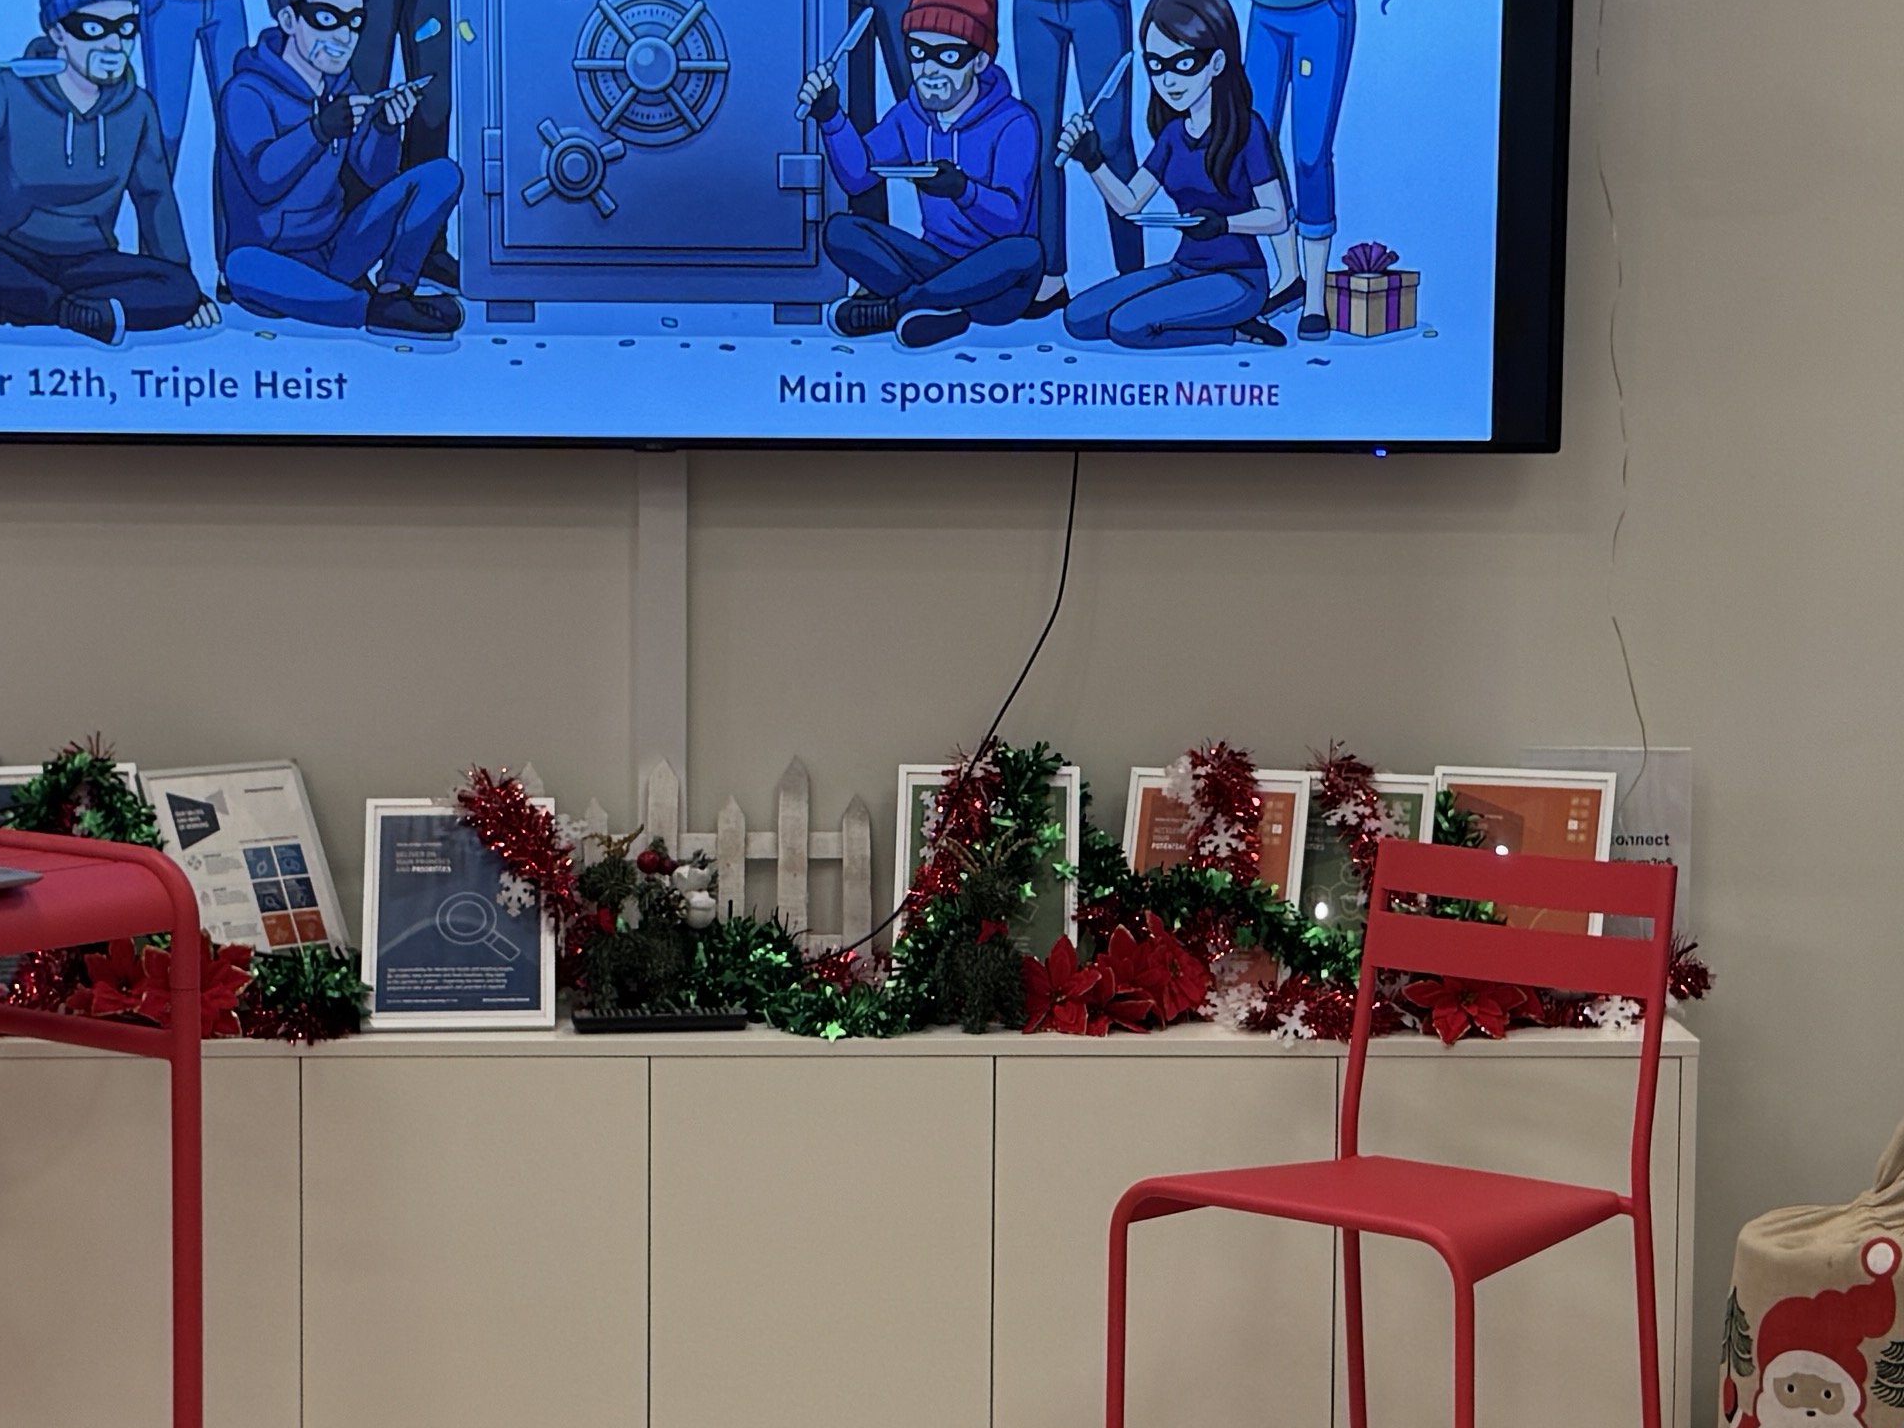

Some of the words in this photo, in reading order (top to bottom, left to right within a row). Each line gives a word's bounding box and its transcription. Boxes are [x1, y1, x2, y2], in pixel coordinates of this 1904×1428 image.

[26, 367, 118, 405] 12th,
[130, 368, 239, 403] Triple
[253, 369, 349, 402] Heist
[778, 371, 867, 405] Main
[1039, 380, 1170, 406] SPRINGER
[1176, 380, 1280, 408] NATURE
